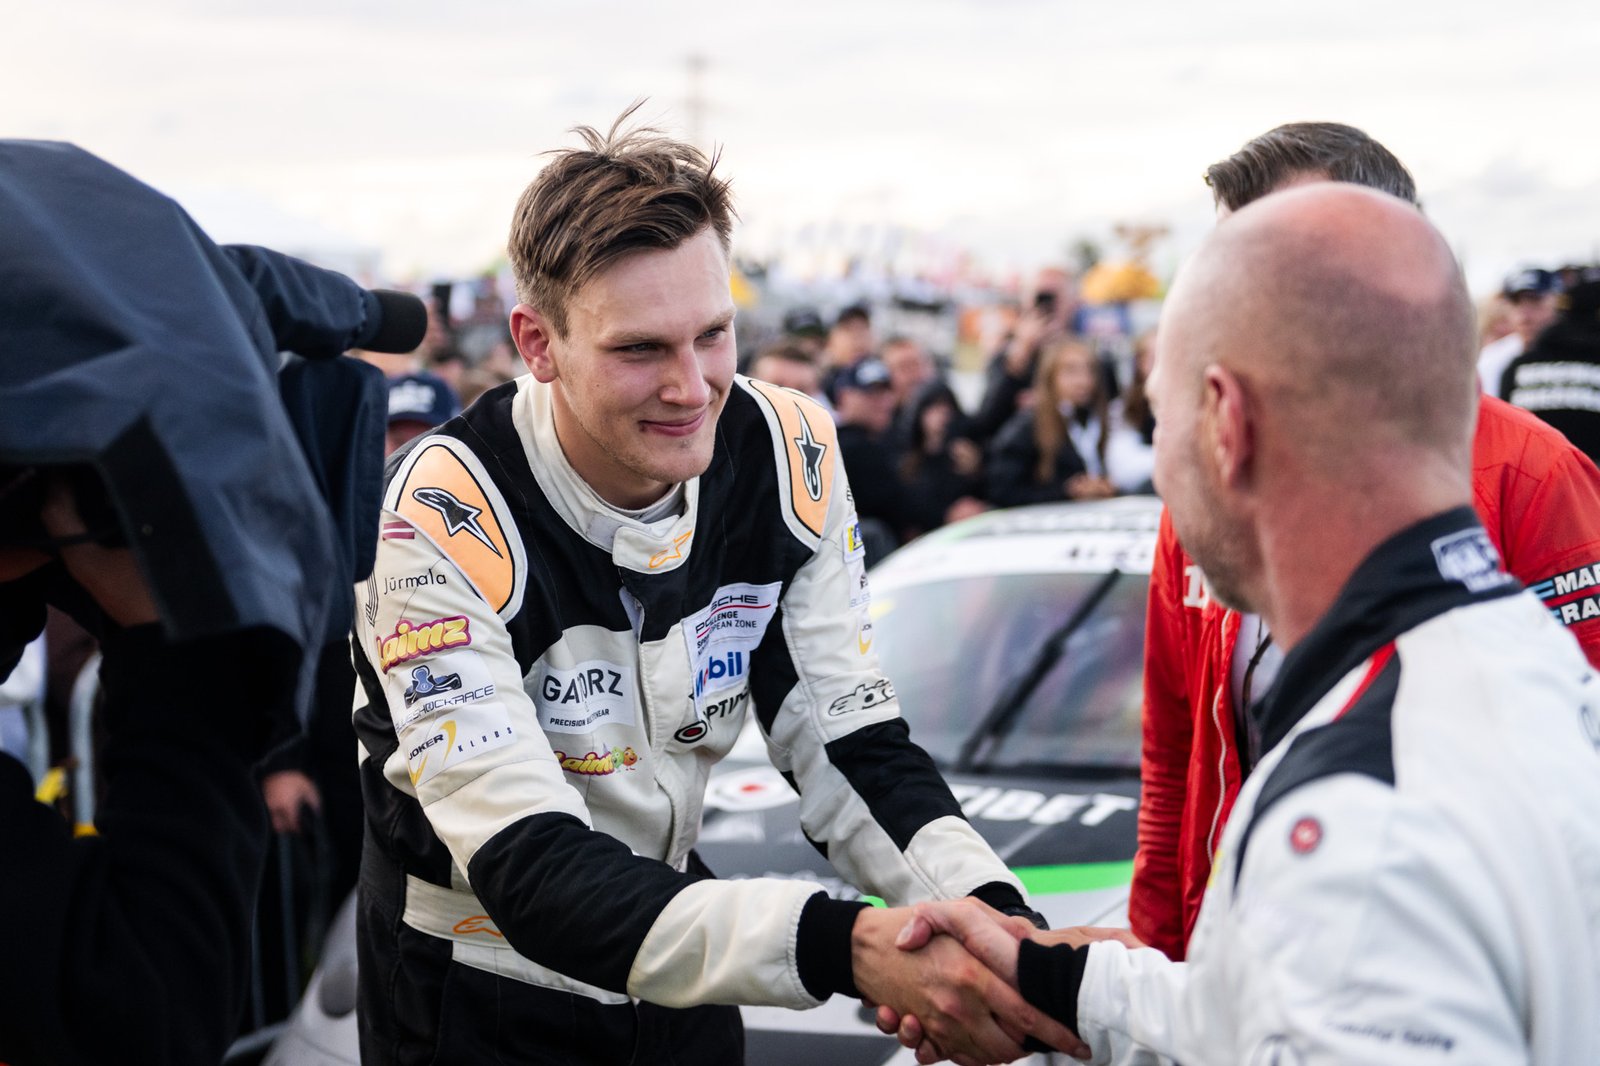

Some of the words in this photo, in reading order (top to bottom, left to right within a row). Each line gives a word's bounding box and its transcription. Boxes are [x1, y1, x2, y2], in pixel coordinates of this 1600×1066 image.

[384, 568, 447, 595] Jūrmala
[735, 620, 757, 629] ZONE
[409, 734, 445, 760] JOKER
